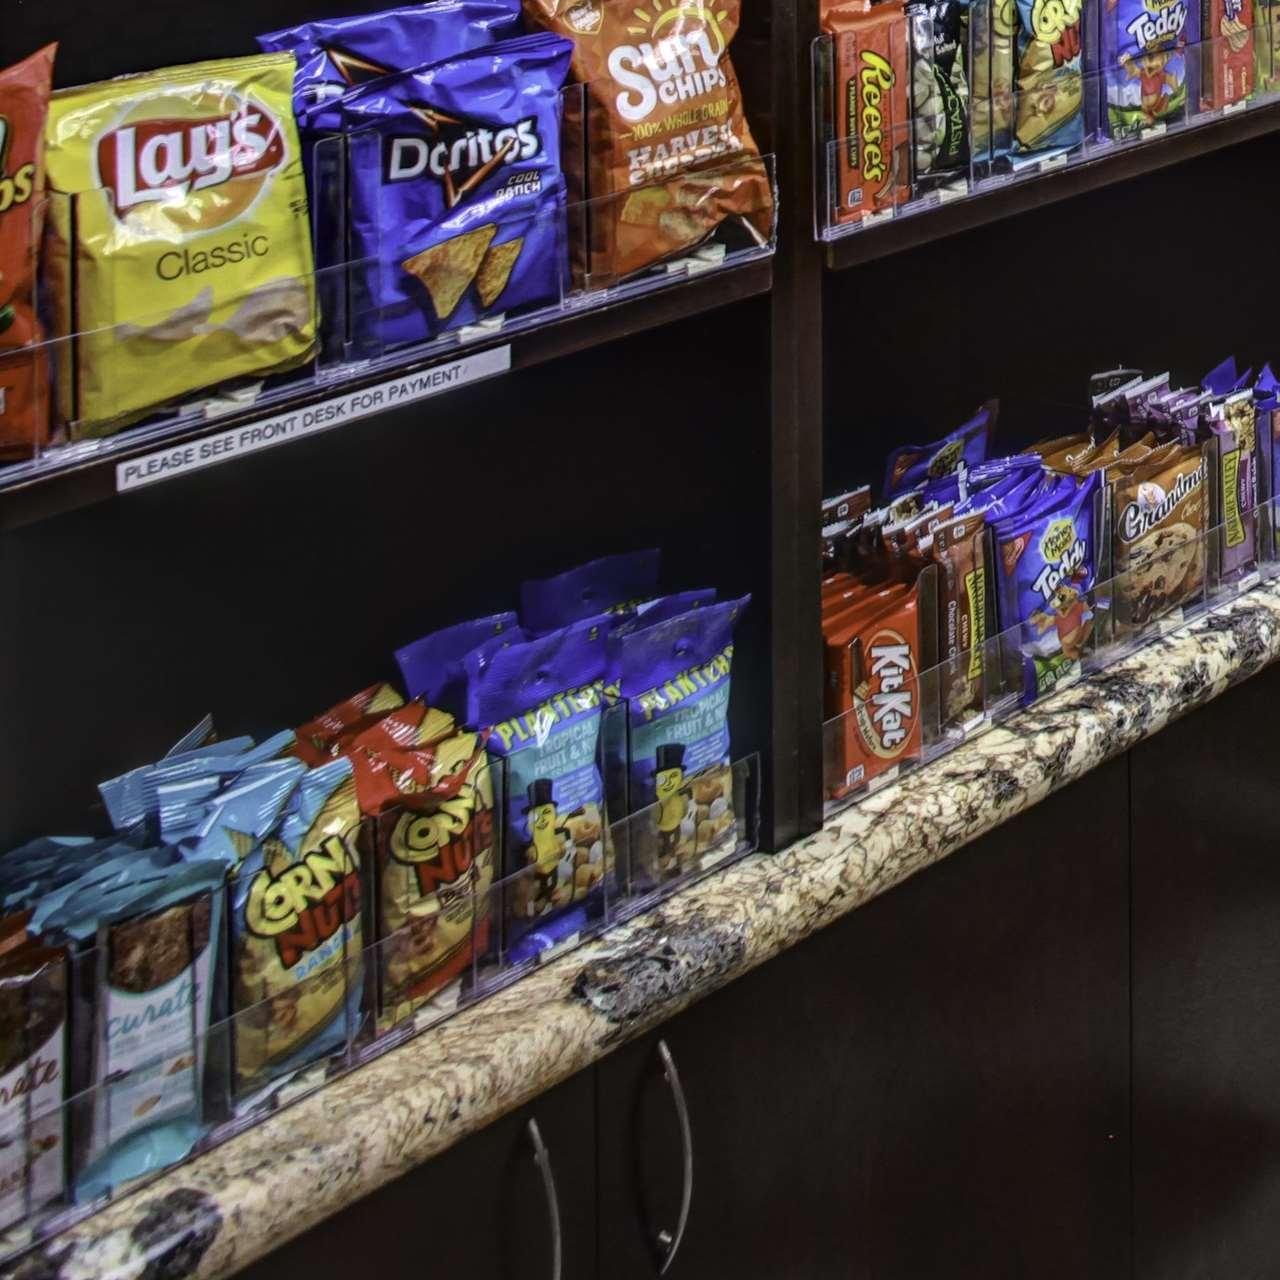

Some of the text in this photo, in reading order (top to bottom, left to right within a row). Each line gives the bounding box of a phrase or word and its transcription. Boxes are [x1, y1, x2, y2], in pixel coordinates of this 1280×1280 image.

[1128, 2, 1188, 49] Teddy
[607, 29, 720, 121] Sun
[632, 121, 661, 141] 100%
[664, 108, 700, 131] WHOLE
[860, 51, 896, 182] Reese's
[390, 120, 540, 180] Doritos
[156, 232, 271, 282] Classic
[123, 365, 463, 483] PLEASE SEE FRONT DESK FOR PAYMENT
[1223, 455, 1239, 497] VALLEY
[1032, 539, 1086, 601] Teddy
[947, 600, 957, 646] Chocolate
[246, 835, 354, 937] CORN
